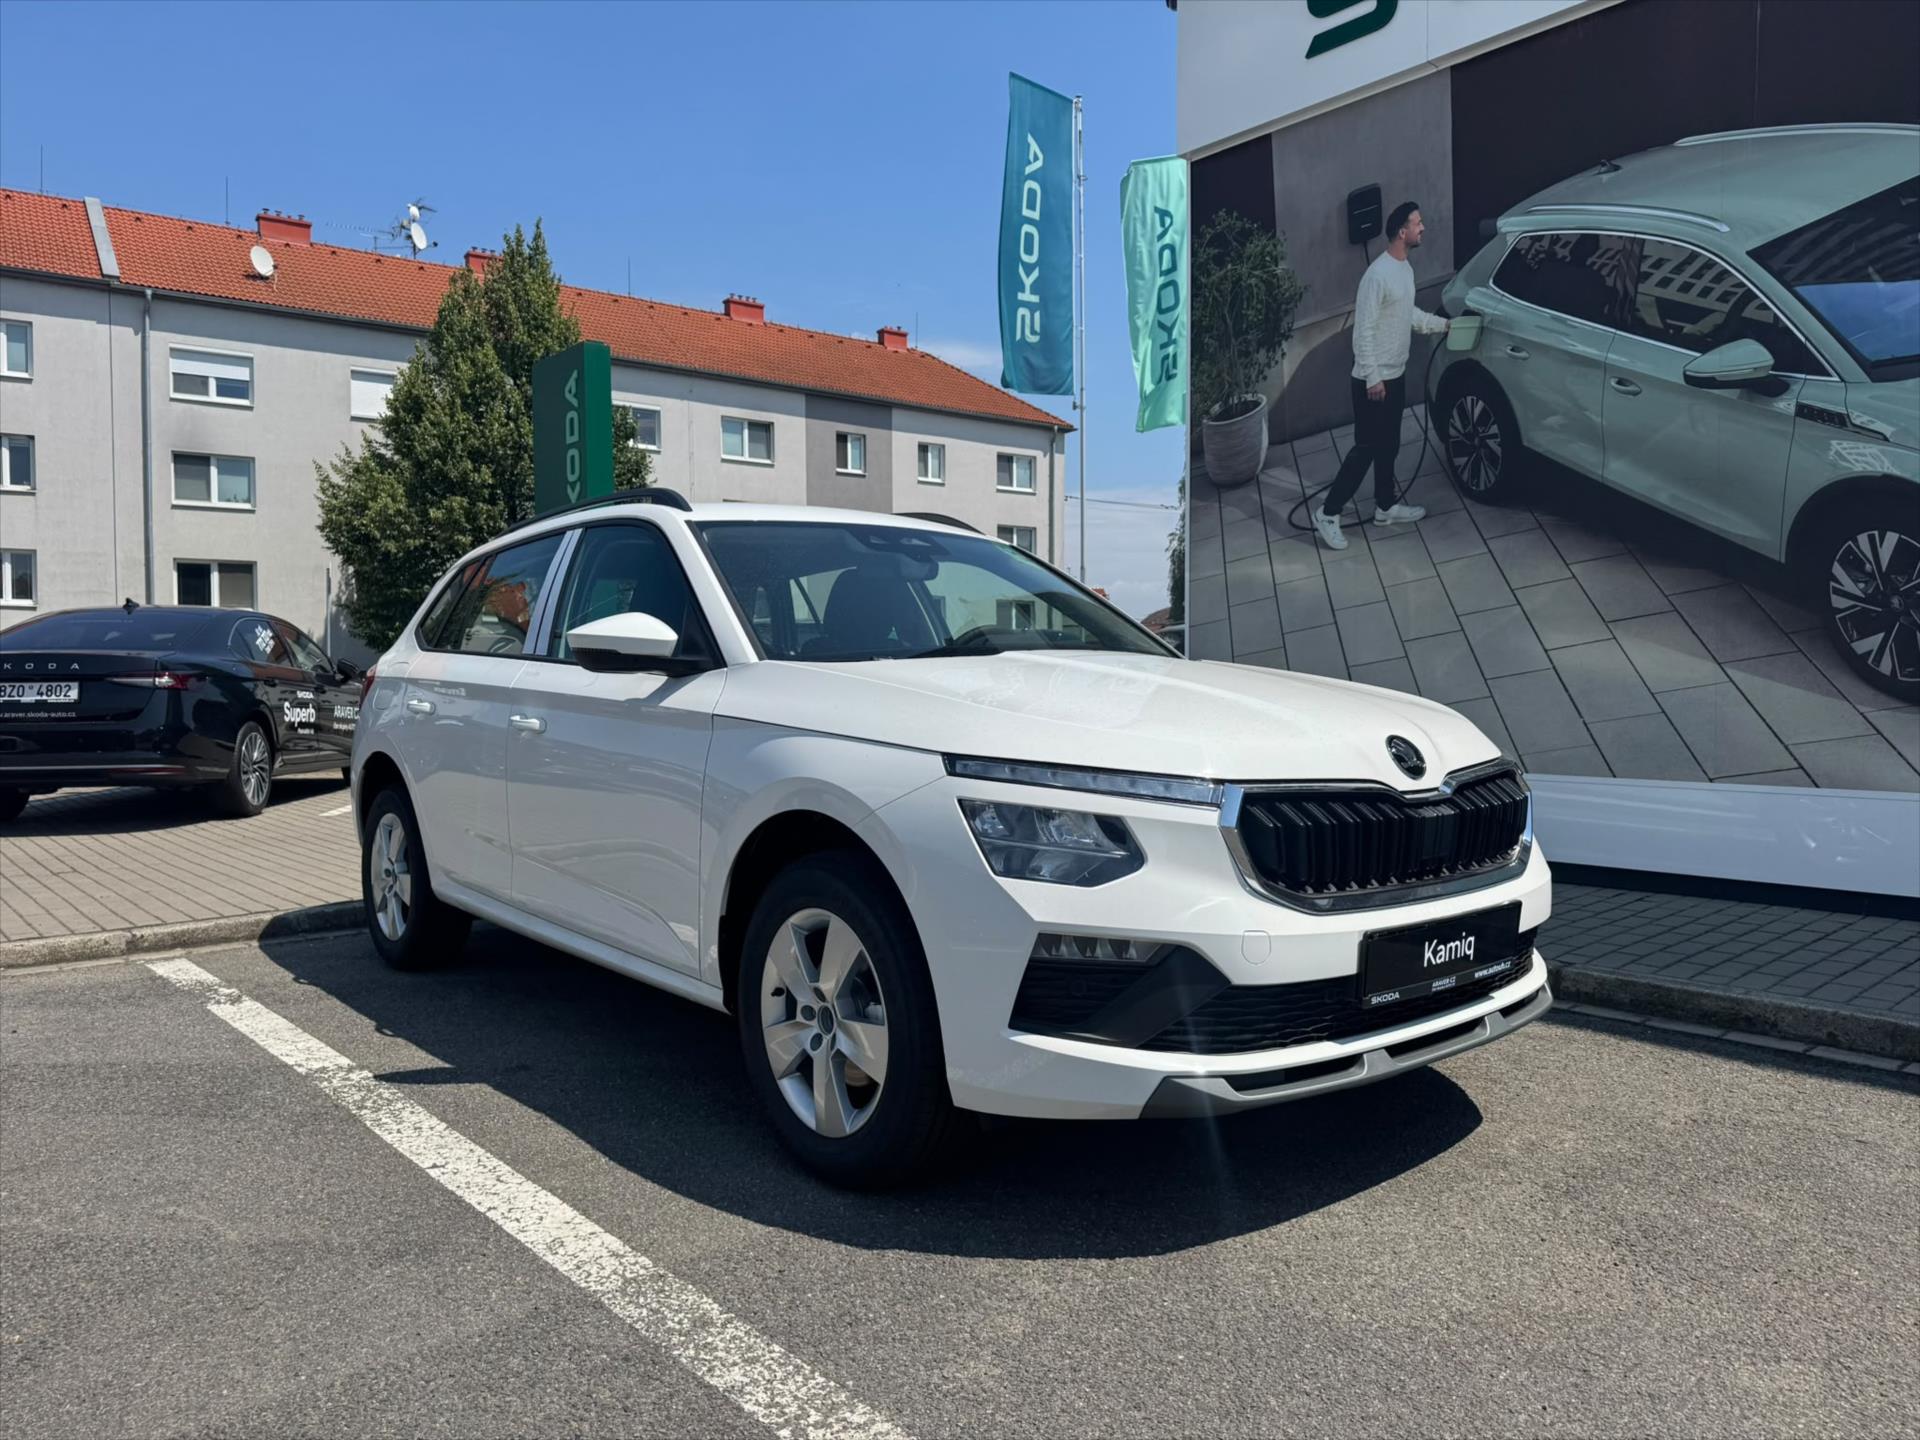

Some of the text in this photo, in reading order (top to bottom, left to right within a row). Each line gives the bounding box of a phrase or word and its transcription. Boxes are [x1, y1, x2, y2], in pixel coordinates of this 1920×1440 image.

[564, 369, 581, 504] KODA
[3, 662, 80, 670] KODA
[36, 684, 72, 698] 4802
[284, 702, 316, 727] Superb
[1423, 931, 1475, 968] Kamiq
